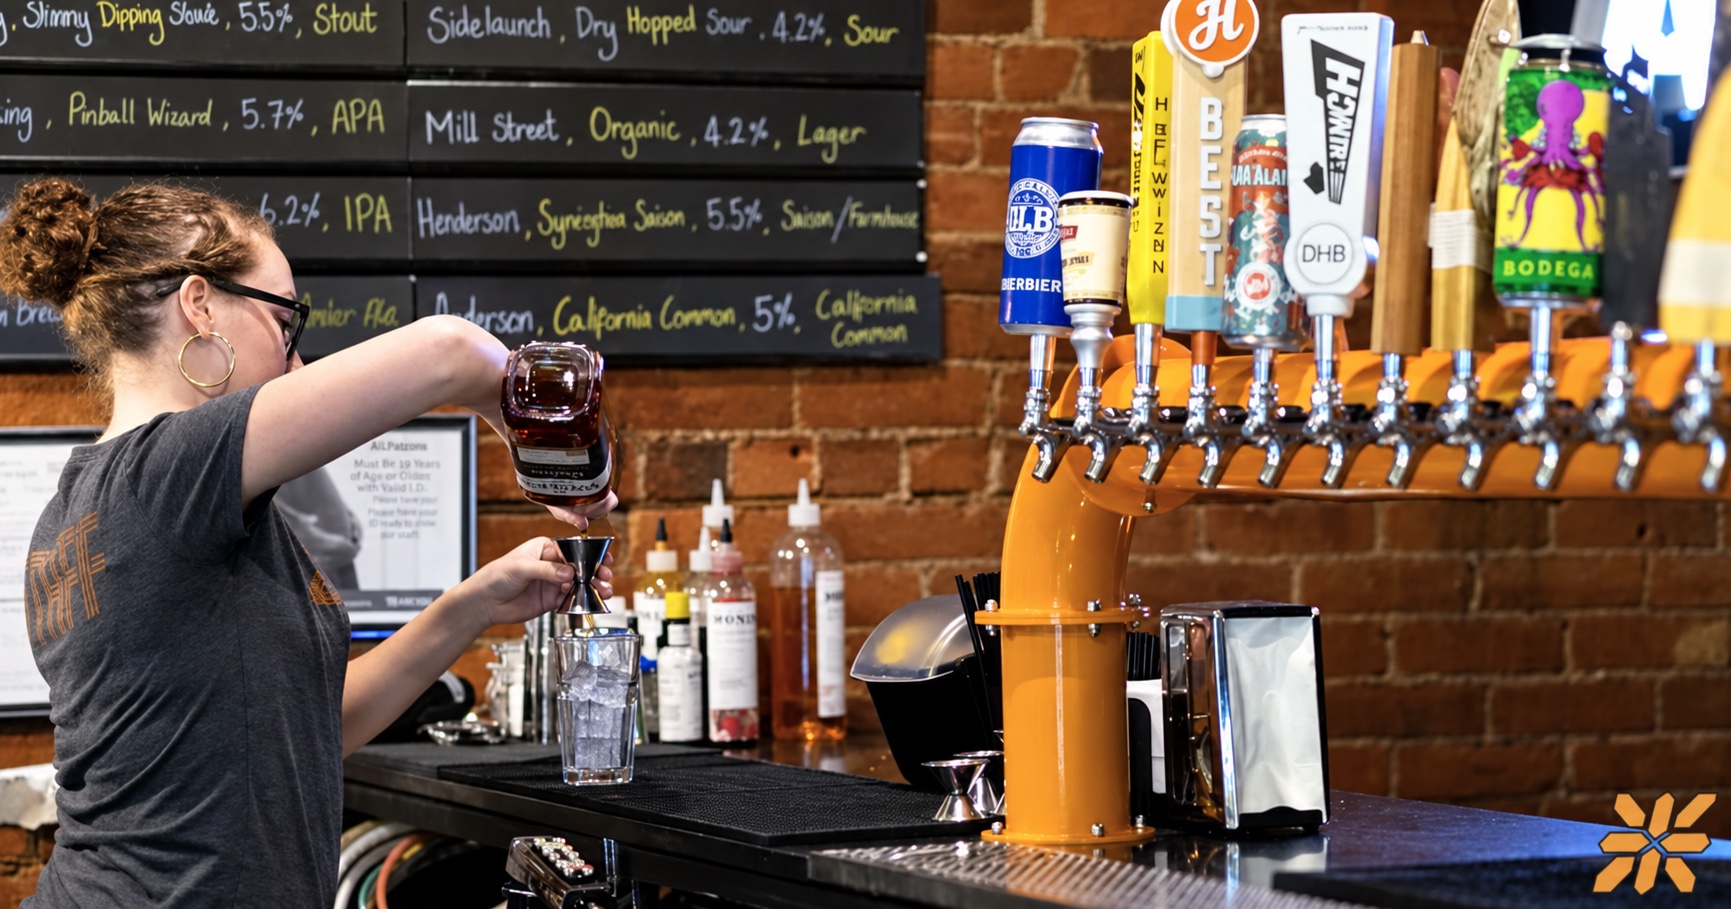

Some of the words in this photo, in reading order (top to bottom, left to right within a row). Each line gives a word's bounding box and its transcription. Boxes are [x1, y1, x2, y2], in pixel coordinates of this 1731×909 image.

[96, 1, 165, 46] Dipping
[313, 2, 378, 35] Stout
[575, 6, 619, 62] Dry
[627, 3, 697, 46] Hopped
[844, 14, 900, 47] Sour
[68, 91, 135, 126] Pinball
[331, 98, 385, 135] APA
[425, 110, 480, 145] Mill
[797, 113, 868, 164] Lager
[344, 193, 392, 234] IPA
[1199, 97, 1223, 286] BEST
[1302, 243, 1346, 263] DHB
[1503, 260, 1594, 280] BODEGA
[553, 294, 653, 341] California
[830, 320, 910, 350] Common
[354, 459, 380, 469] Must
[382, 459, 396, 469] Be
[399, 459, 412, 469] 19
[413, 459, 441, 469] Years
